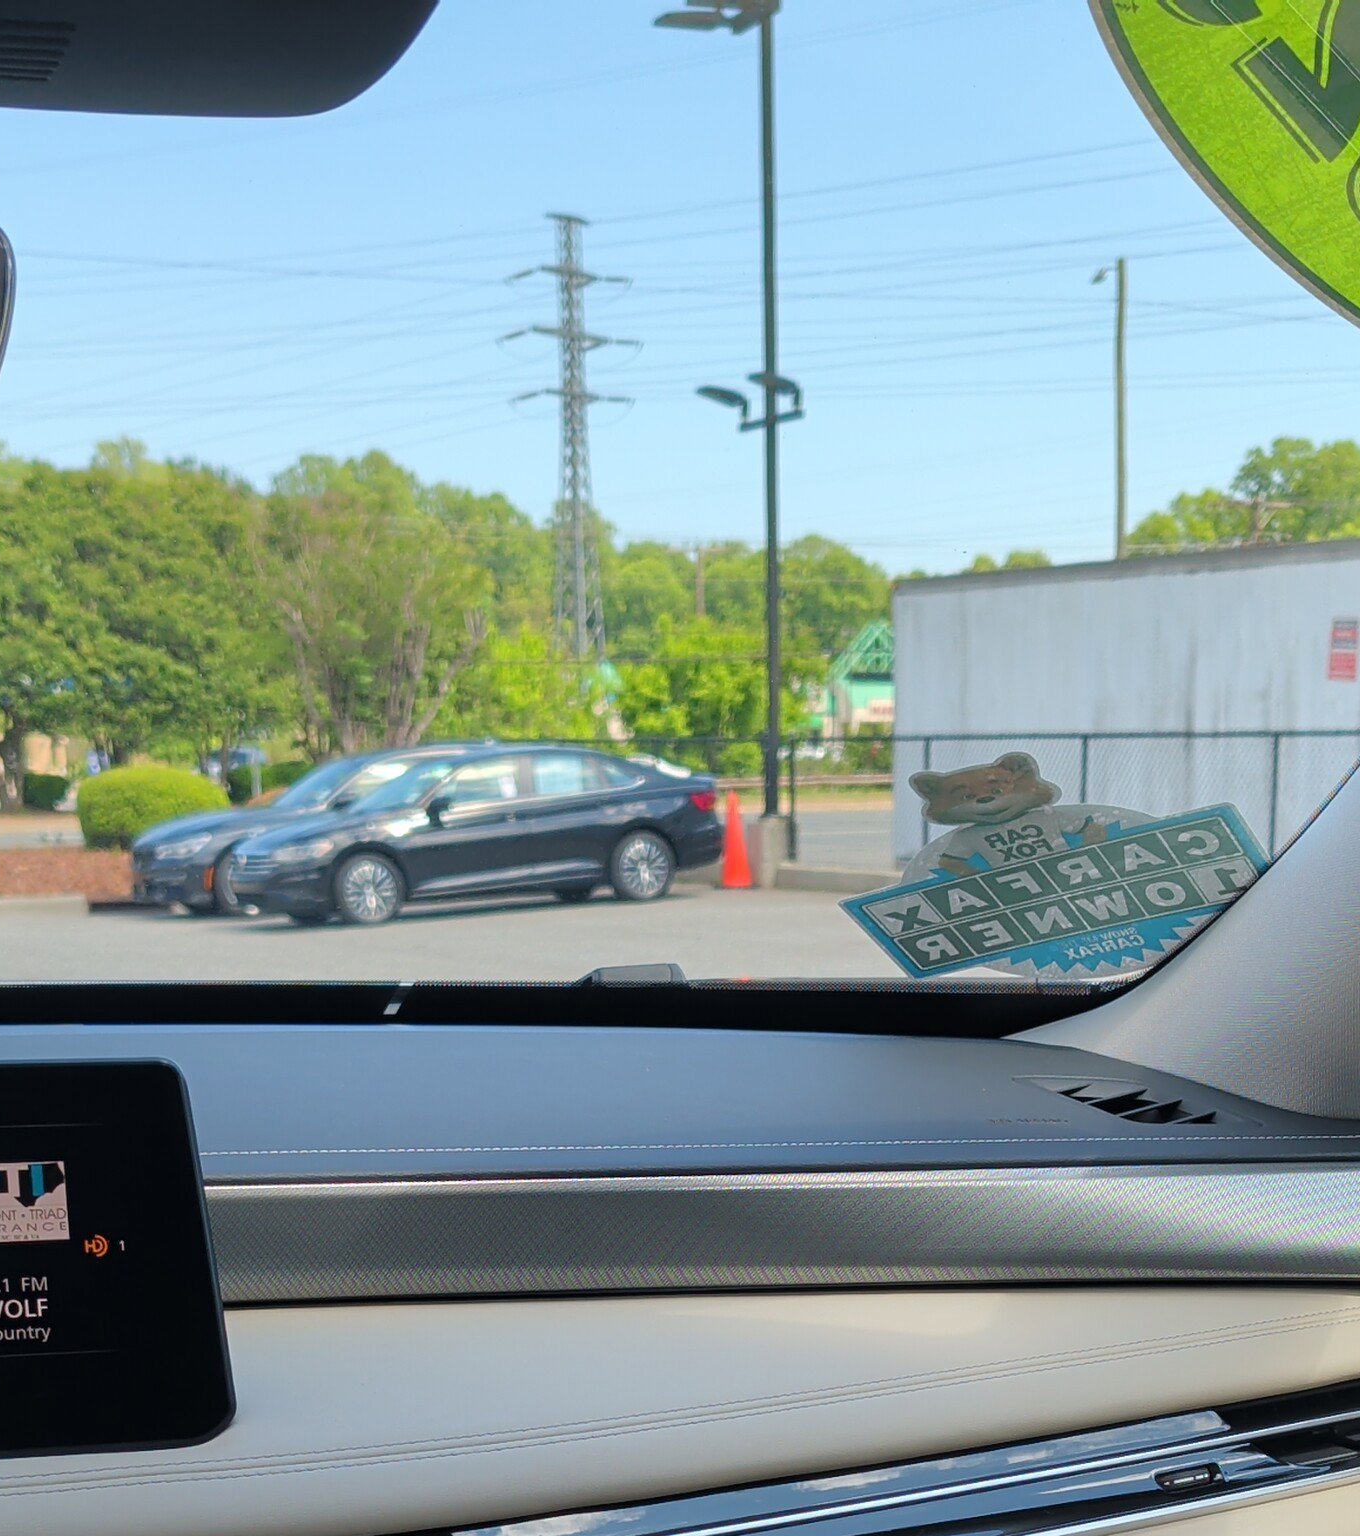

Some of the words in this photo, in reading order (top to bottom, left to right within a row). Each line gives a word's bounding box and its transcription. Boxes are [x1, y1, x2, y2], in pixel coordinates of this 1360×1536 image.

[29, 1208, 67, 1220] TRIAD
[119, 1240, 126, 1251] 1
[21, 1276, 49, 1292] FM
